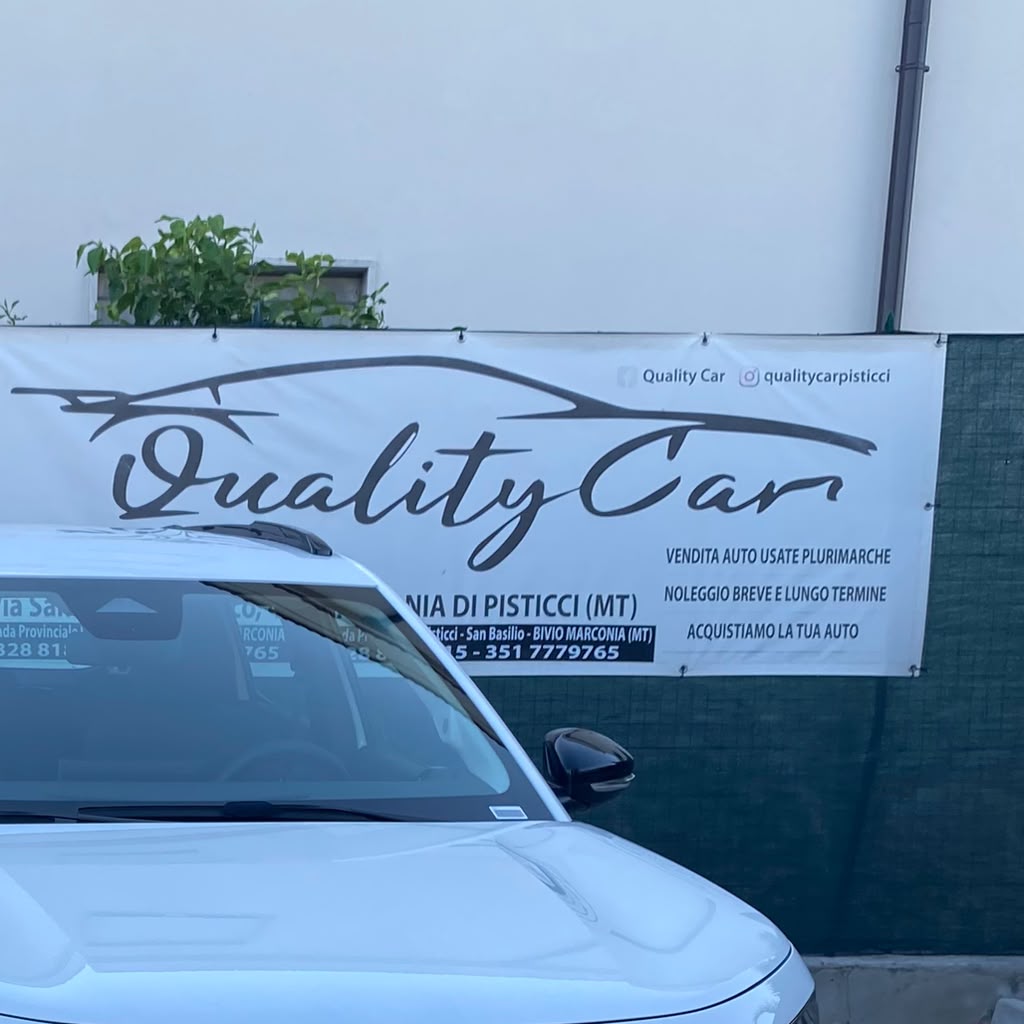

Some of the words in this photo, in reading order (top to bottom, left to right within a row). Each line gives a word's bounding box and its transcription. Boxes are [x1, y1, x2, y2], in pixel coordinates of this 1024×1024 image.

[643, 369, 697, 386] Quality
[700, 369, 726, 383] Car
[764, 369, 891, 386] qualitycarpisticci
[112, 421, 568, 572] Quality
[579, 423, 843, 516] Car
[666, 548, 719, 564] VENDITA
[722, 548, 757, 564] AUTO
[760, 548, 799, 564] USATE
[802, 548, 892, 565] PLURIMARCHE
[664, 586, 730, 602] NOLEGGIO
[733, 586, 772, 602] BREVE
[775, 586, 782, 602] E
[785, 586, 829, 602] LUNGO
[832, 586, 887, 602] TERMINE
[406, 594, 446, 617] NIA
[453, 594, 477, 617] DI
[484, 594, 579, 617] PISTICCI
[586, 593, 638, 620] (MT)
[240, 627, 285, 641] RCONIA
[466, 626, 487, 641] San
[489, 626, 524, 642] Basilio
[533, 627, 563, 642] BIVIO
[566, 627, 626, 642] MARCONIA
[628, 627, 653, 644] (MT)
[687, 623, 775, 641] ACQUISTIAMO
[778, 624, 793, 640] LA
[797, 624, 821, 640] TUA
[824, 624, 859, 640] AUTO
[485, 645, 521, 660] 351
[529, 645, 620, 660] 7779765
